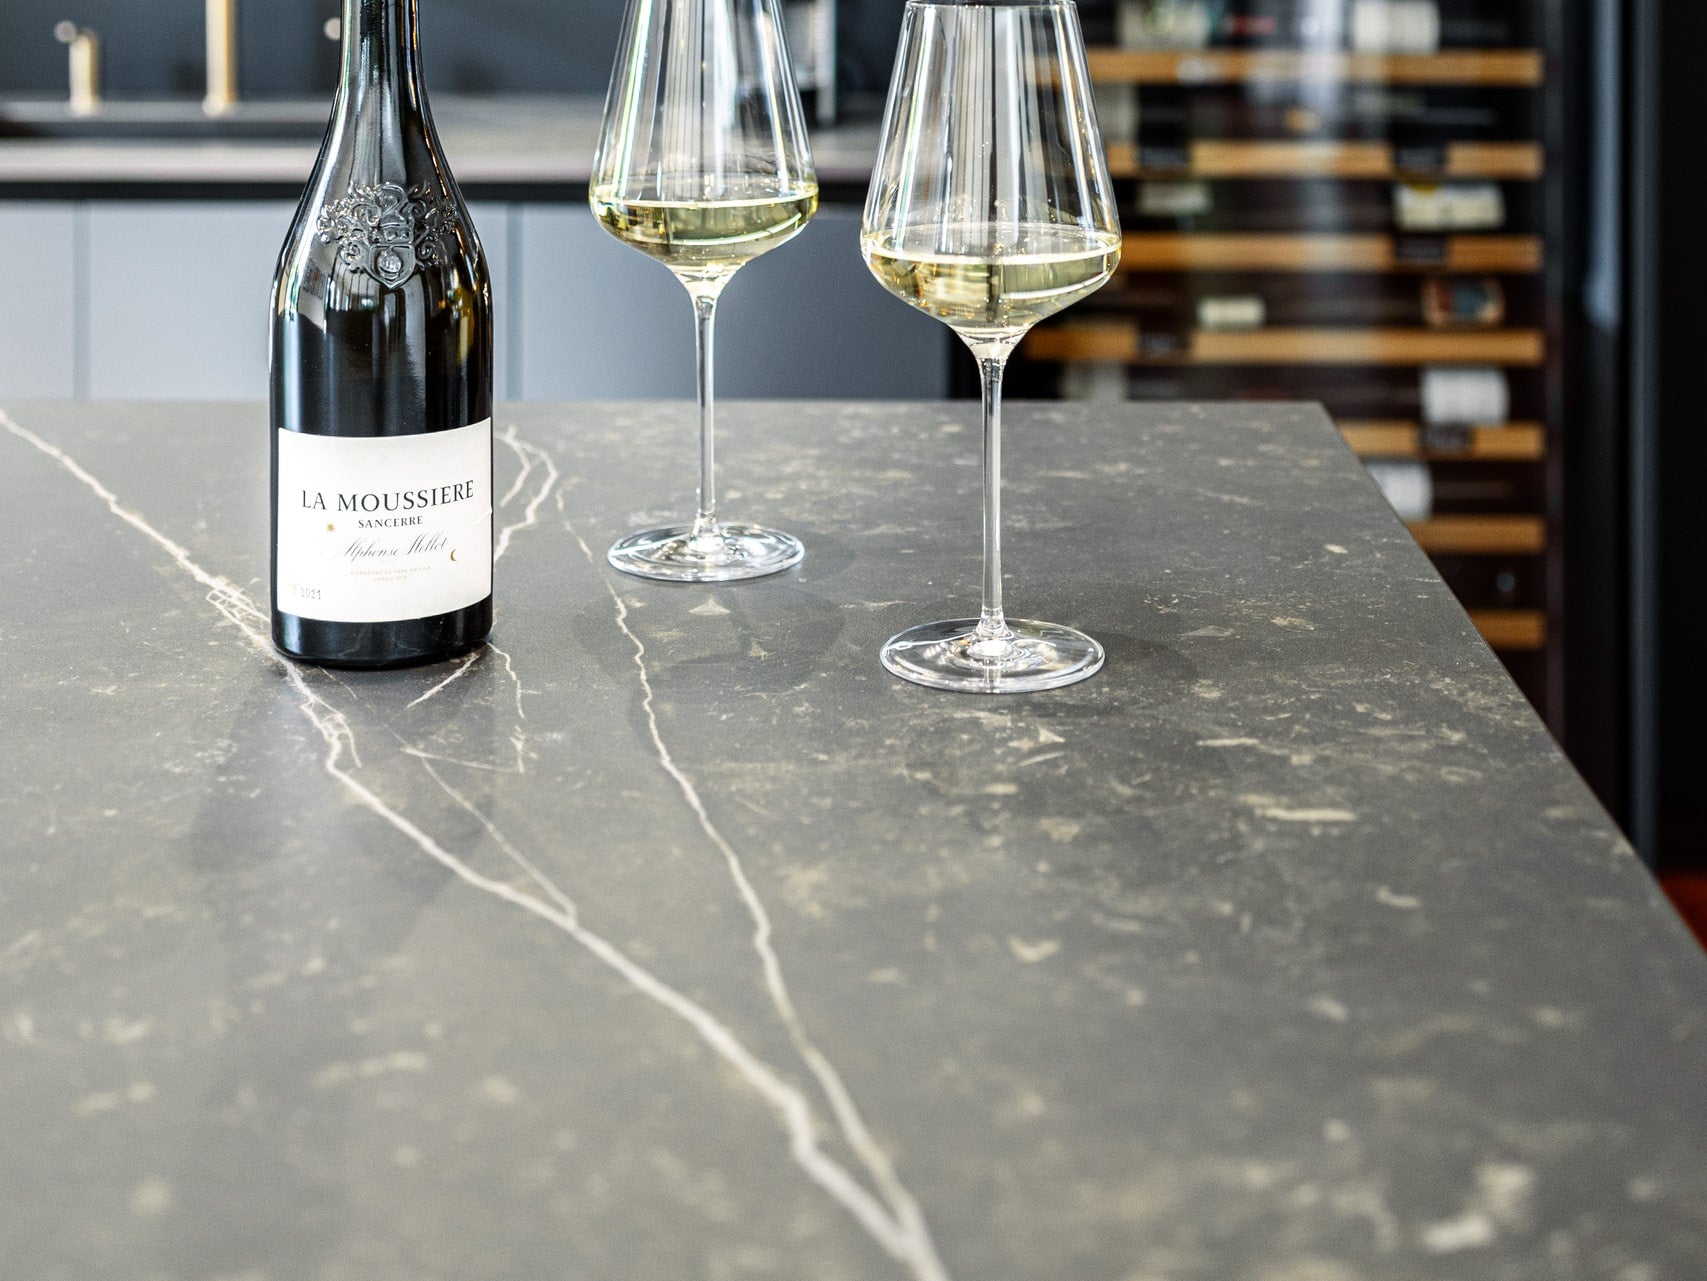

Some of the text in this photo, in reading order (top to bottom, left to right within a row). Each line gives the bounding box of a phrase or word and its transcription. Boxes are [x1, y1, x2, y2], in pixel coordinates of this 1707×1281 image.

[302, 480, 474, 512] LA MOUSSIERE
[358, 515, 423, 529] SANCERRE
[300, 586, 322, 601] 2021
